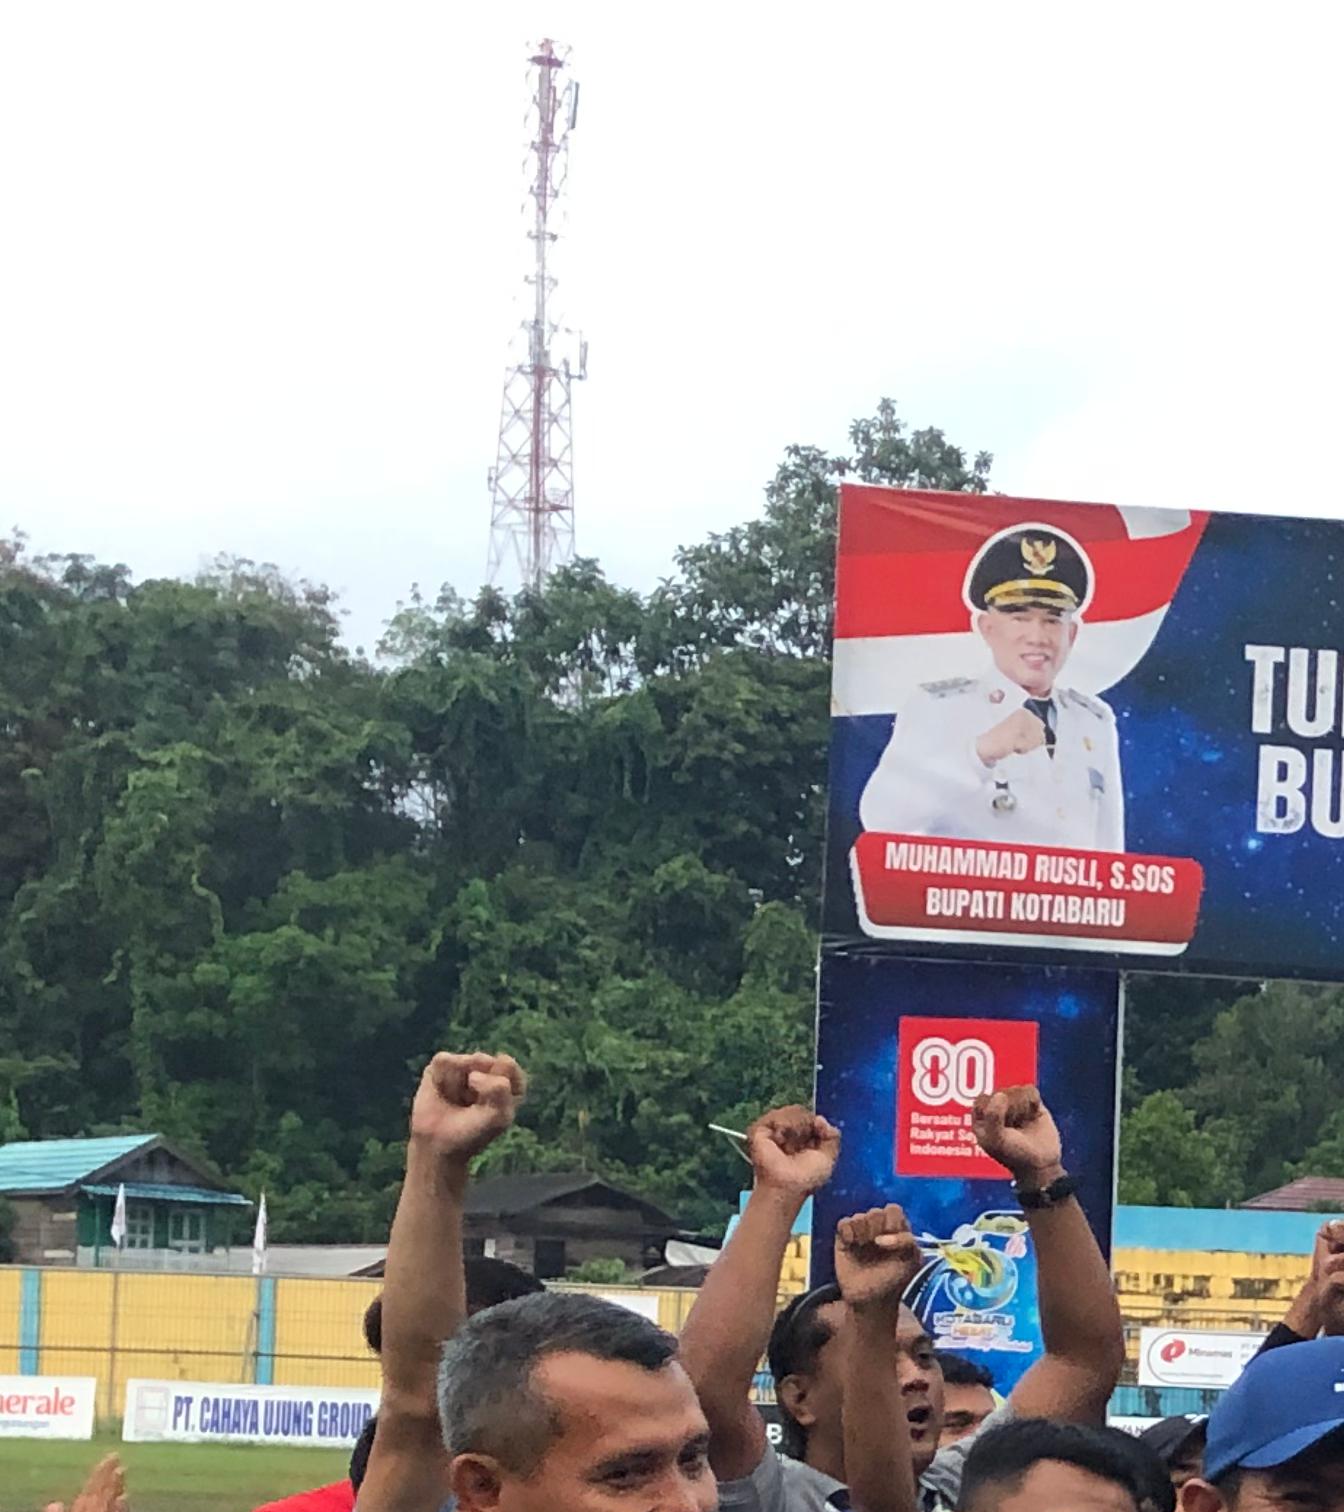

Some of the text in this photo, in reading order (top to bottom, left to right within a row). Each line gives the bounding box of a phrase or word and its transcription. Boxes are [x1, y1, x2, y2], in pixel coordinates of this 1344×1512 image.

[885, 841, 1175, 894] MUHAMMAD RUSLI, S.SOS
[926, 887, 1125, 926] BUPATI KOTABARU
[912, 1037, 995, 1106] 80
[172, 1395, 373, 1439] PT. CAHAYA UJUNG GROUP
